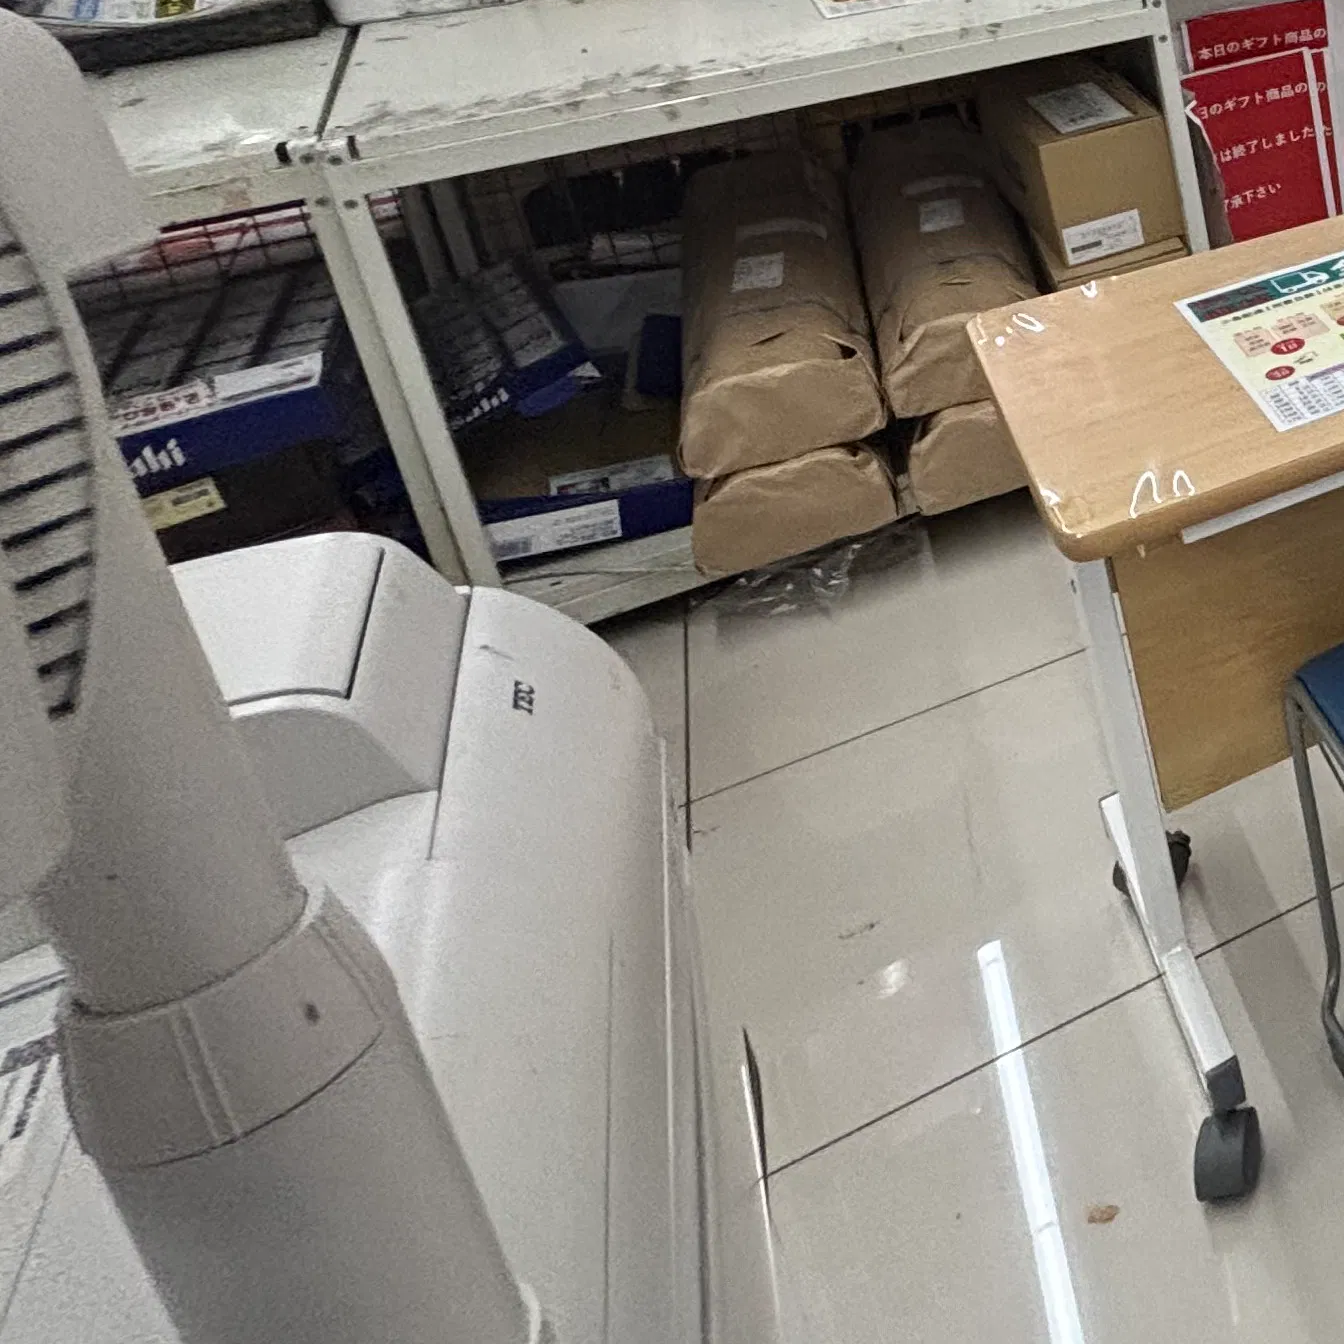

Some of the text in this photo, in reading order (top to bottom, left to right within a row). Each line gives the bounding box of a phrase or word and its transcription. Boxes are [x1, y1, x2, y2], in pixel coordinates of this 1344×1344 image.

[1198, 27, 1327, 61] 本日のギフト商品の
[511, 679, 537, 715] TEC
